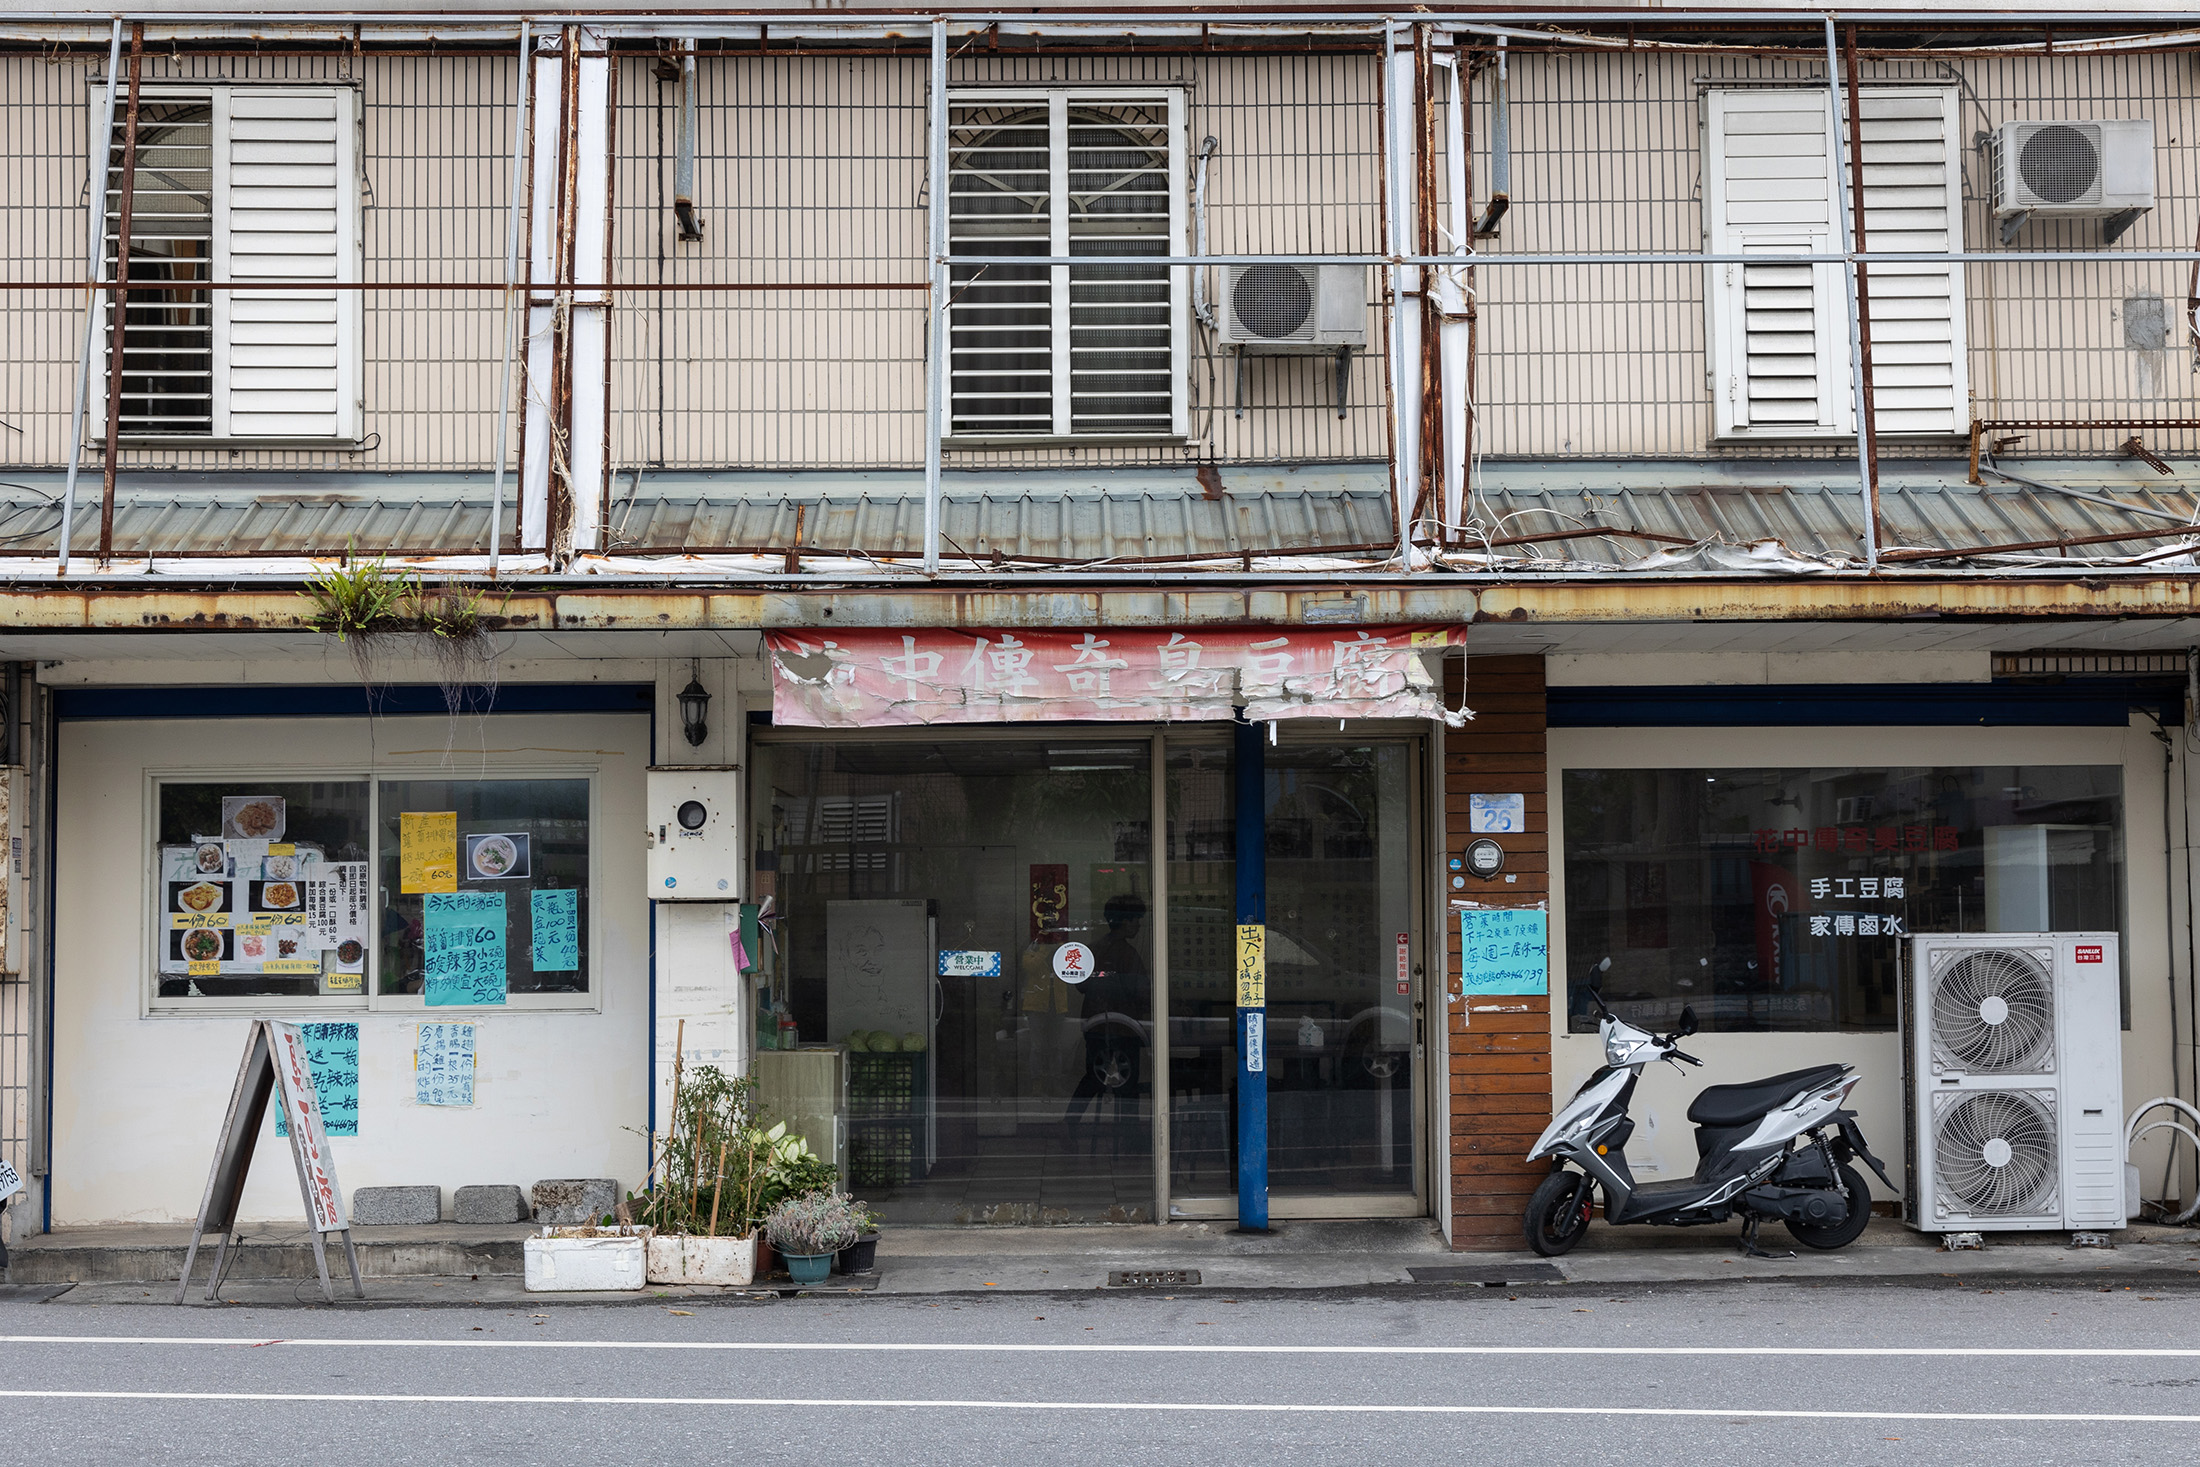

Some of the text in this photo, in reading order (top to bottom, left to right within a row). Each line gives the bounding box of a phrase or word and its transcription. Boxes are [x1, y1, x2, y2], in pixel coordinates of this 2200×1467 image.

[1753, 826, 1960, 854] 花中傳奇臭豆腐
[1810, 876, 1905, 900] 手工豆腐
[428, 893, 503, 912] 今天的湯品
[1463, 911, 1513, 930] 營業時間
[1241, 926, 1260, 968] 出入口
[954, 955, 984, 965] 營業中
[1065, 948, 1083, 970] 愛
[1252, 969, 1264, 1005] 車子
